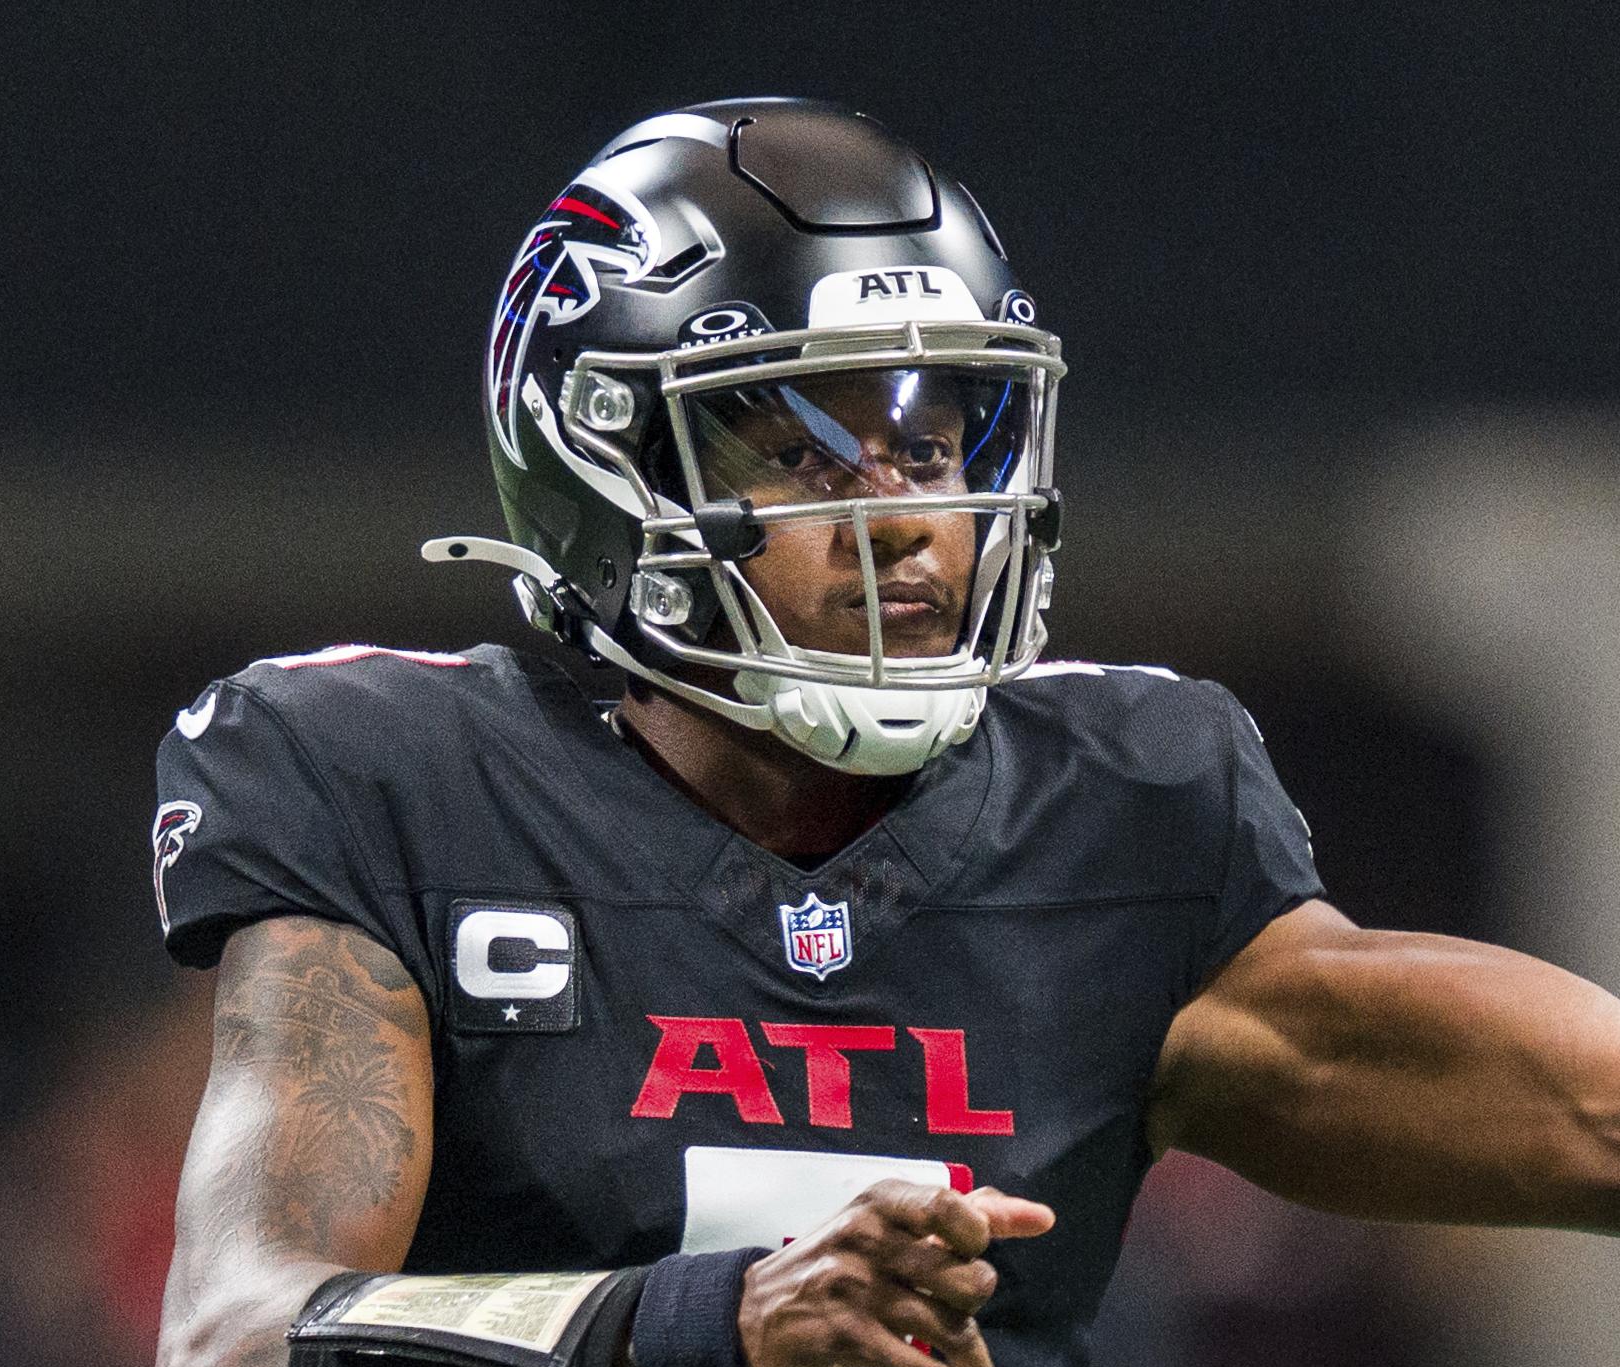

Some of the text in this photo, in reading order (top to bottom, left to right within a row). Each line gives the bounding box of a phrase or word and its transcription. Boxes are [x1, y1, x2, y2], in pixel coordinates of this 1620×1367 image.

[858, 271, 942, 299] ATL
[456, 911, 570, 999] C
[795, 932, 843, 964] NFL
[630, 1014, 1015, 1136] ATL
